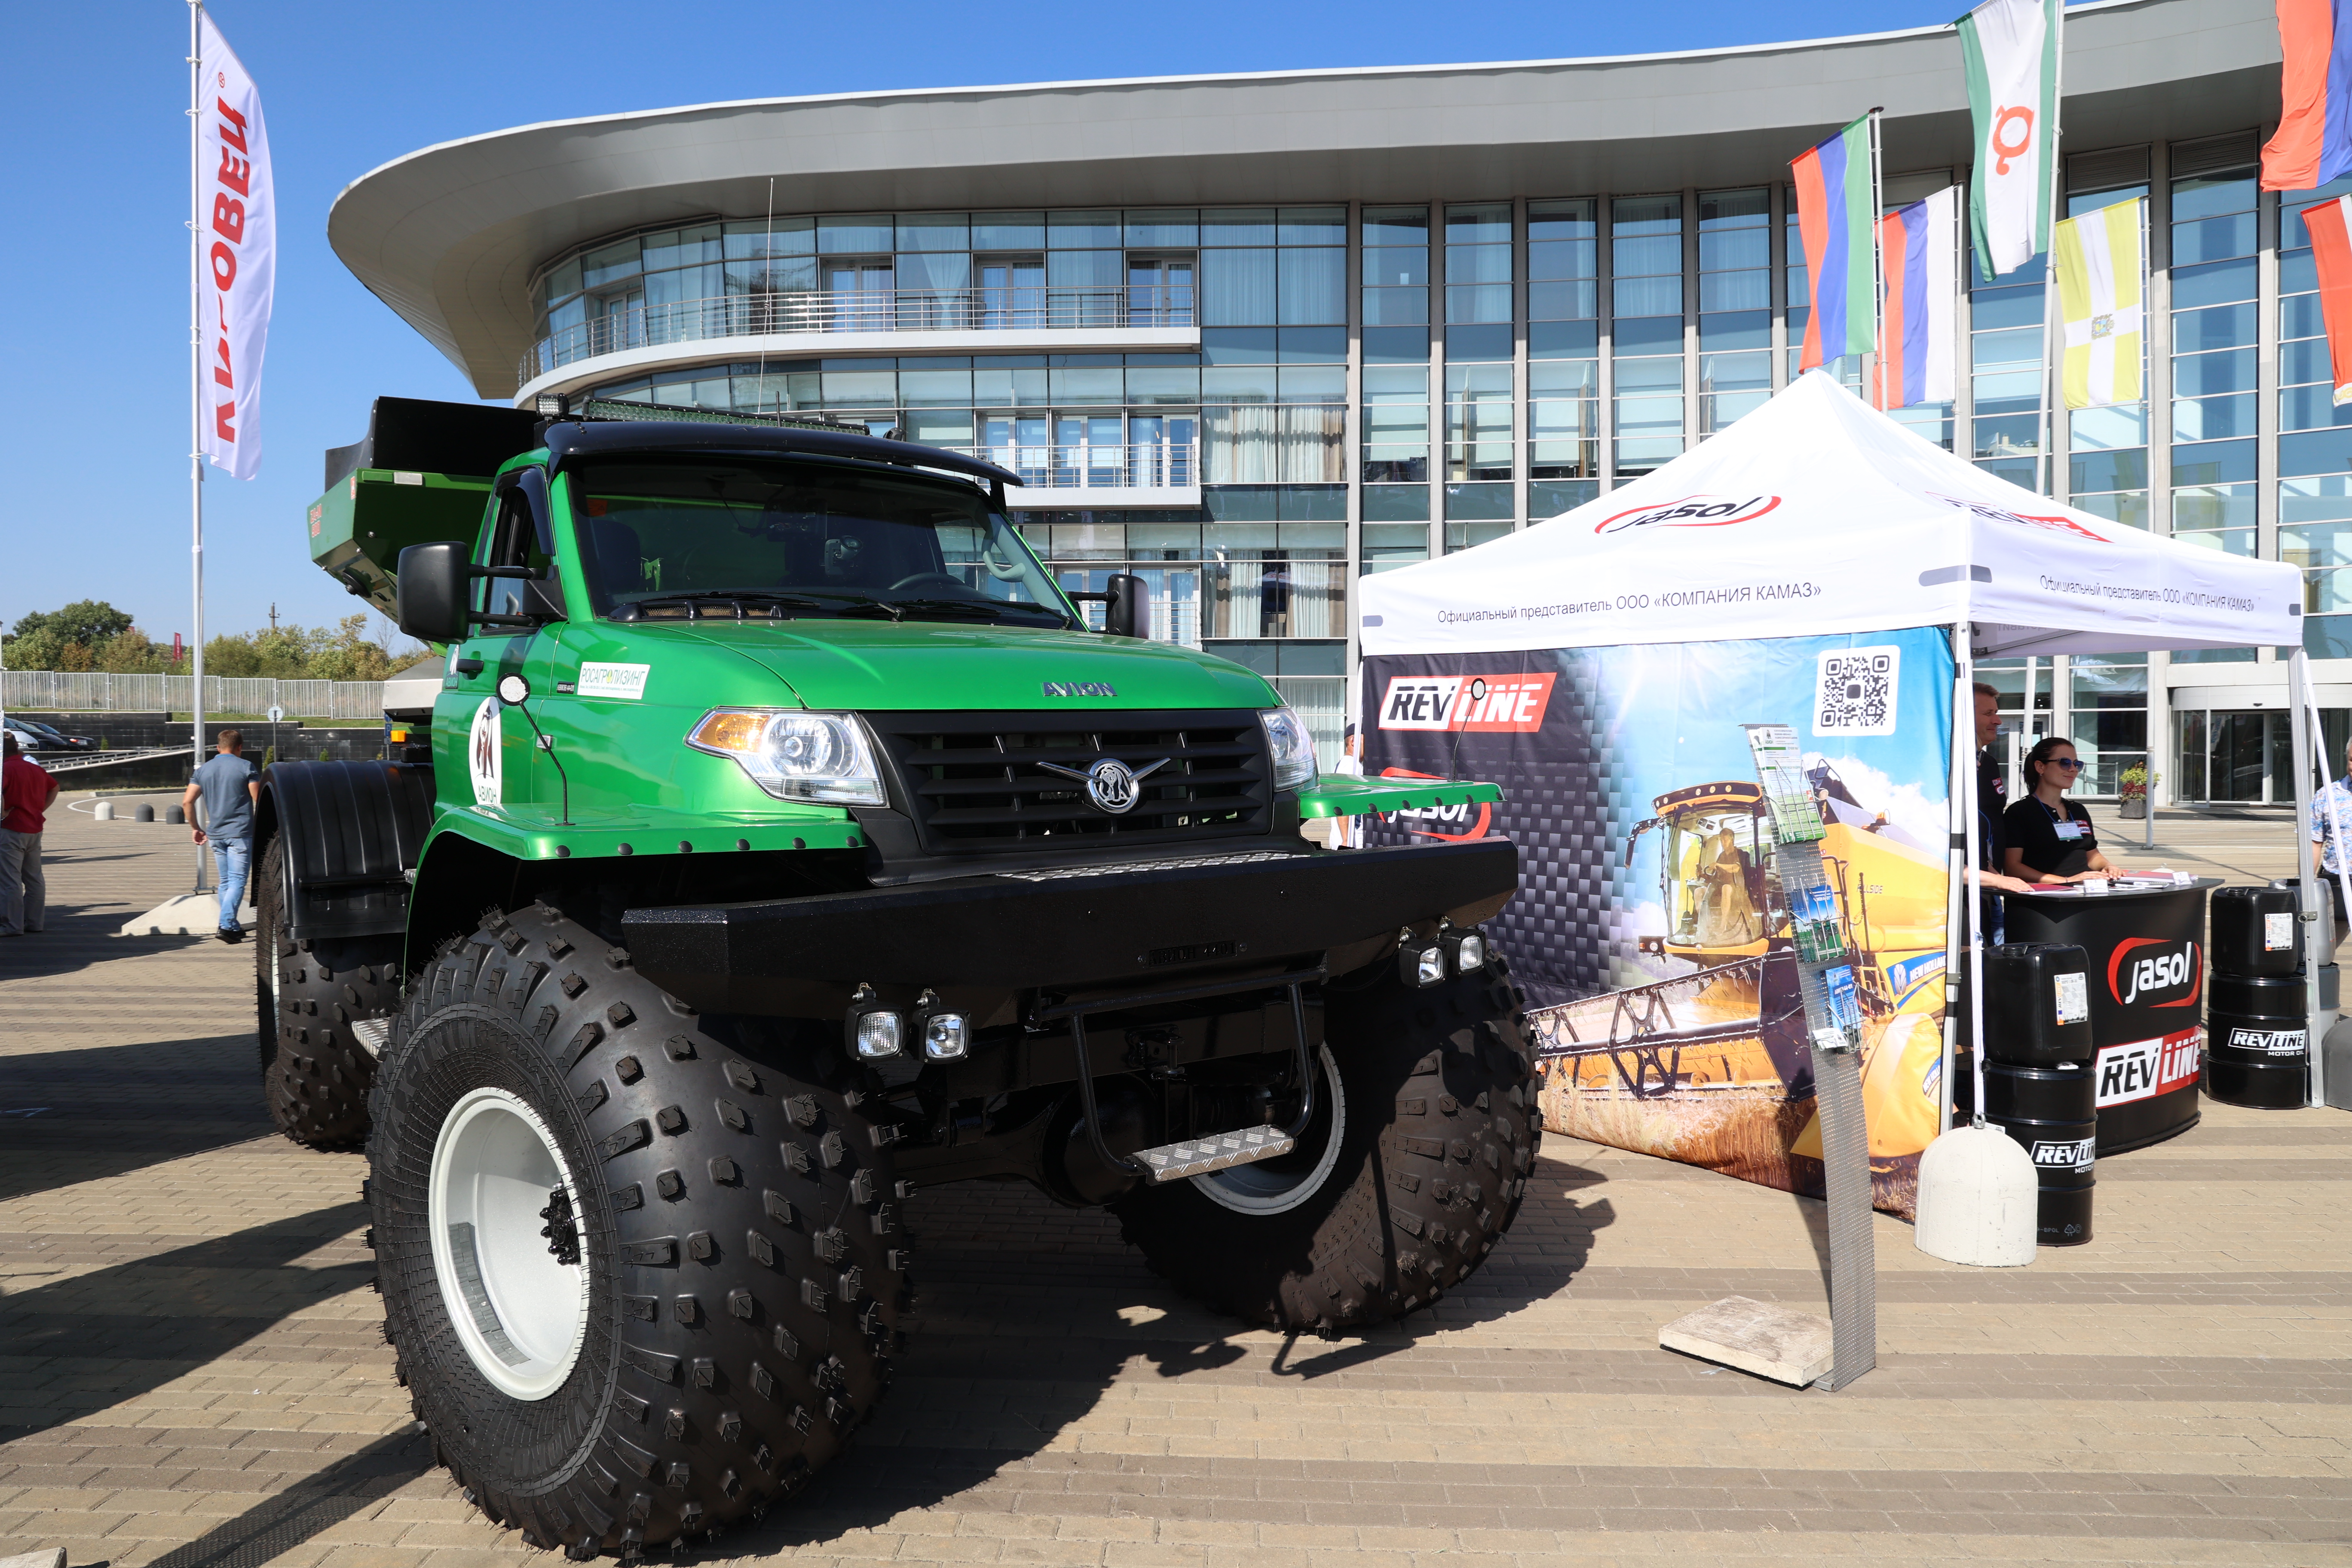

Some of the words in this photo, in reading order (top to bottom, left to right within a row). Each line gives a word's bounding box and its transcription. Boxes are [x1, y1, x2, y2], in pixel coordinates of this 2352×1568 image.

[2040, 575, 2102, 596] Официальный
[2103, 586, 2161, 603] представитель
[2163, 588, 2180, 603] ООО
[2183, 592, 2226, 609] «КОМПАНИЯ
[2228, 597, 2254, 612] КАМАЗ»
[1438, 606, 1517, 626] Официальный
[1521, 600, 1611, 621] представитель
[1616, 594, 1649, 609] ООО
[1654, 587, 1751, 608] «КОМПАНИЯ
[1756, 582, 1821, 601] КАМАЗ»
[581, 668, 646, 686] РОСАГРОЛИЗИНГ
[1041, 682, 1118, 697] AVION
[478, 785, 497, 804] АВИОН
[1203, 941, 1236, 957] 4401
[1910, 964, 1924, 983] NEW
[2125, 941, 2192, 1004] jasol
[2075, 1164, 2094, 1174] MOTOR
